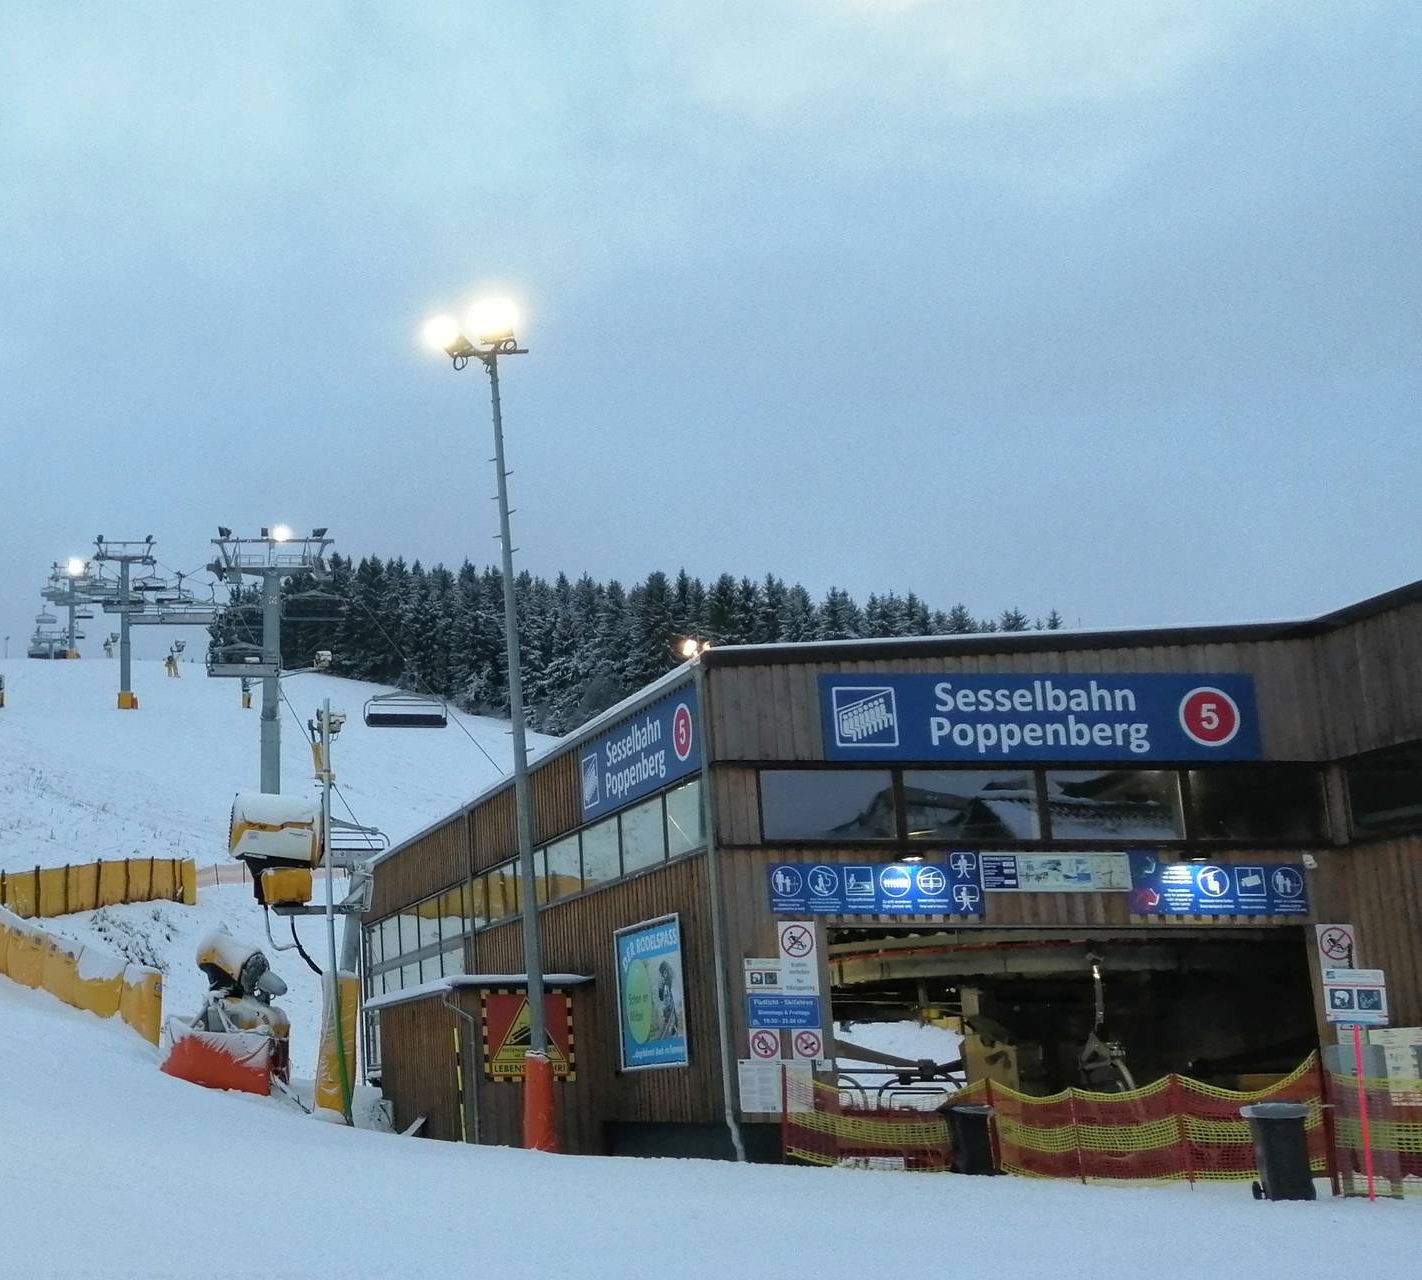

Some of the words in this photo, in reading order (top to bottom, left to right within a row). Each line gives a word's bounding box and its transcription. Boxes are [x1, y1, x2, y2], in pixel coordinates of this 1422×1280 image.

[934, 680, 1137, 712] Sesselbahn
[679, 718, 686, 745] 5
[930, 714, 1151, 754] Poppenberg
[1200, 703, 1220, 730] 5
[605, 716, 661, 767] Sesselbahn
[605, 749, 666, 799] Poppenberg
